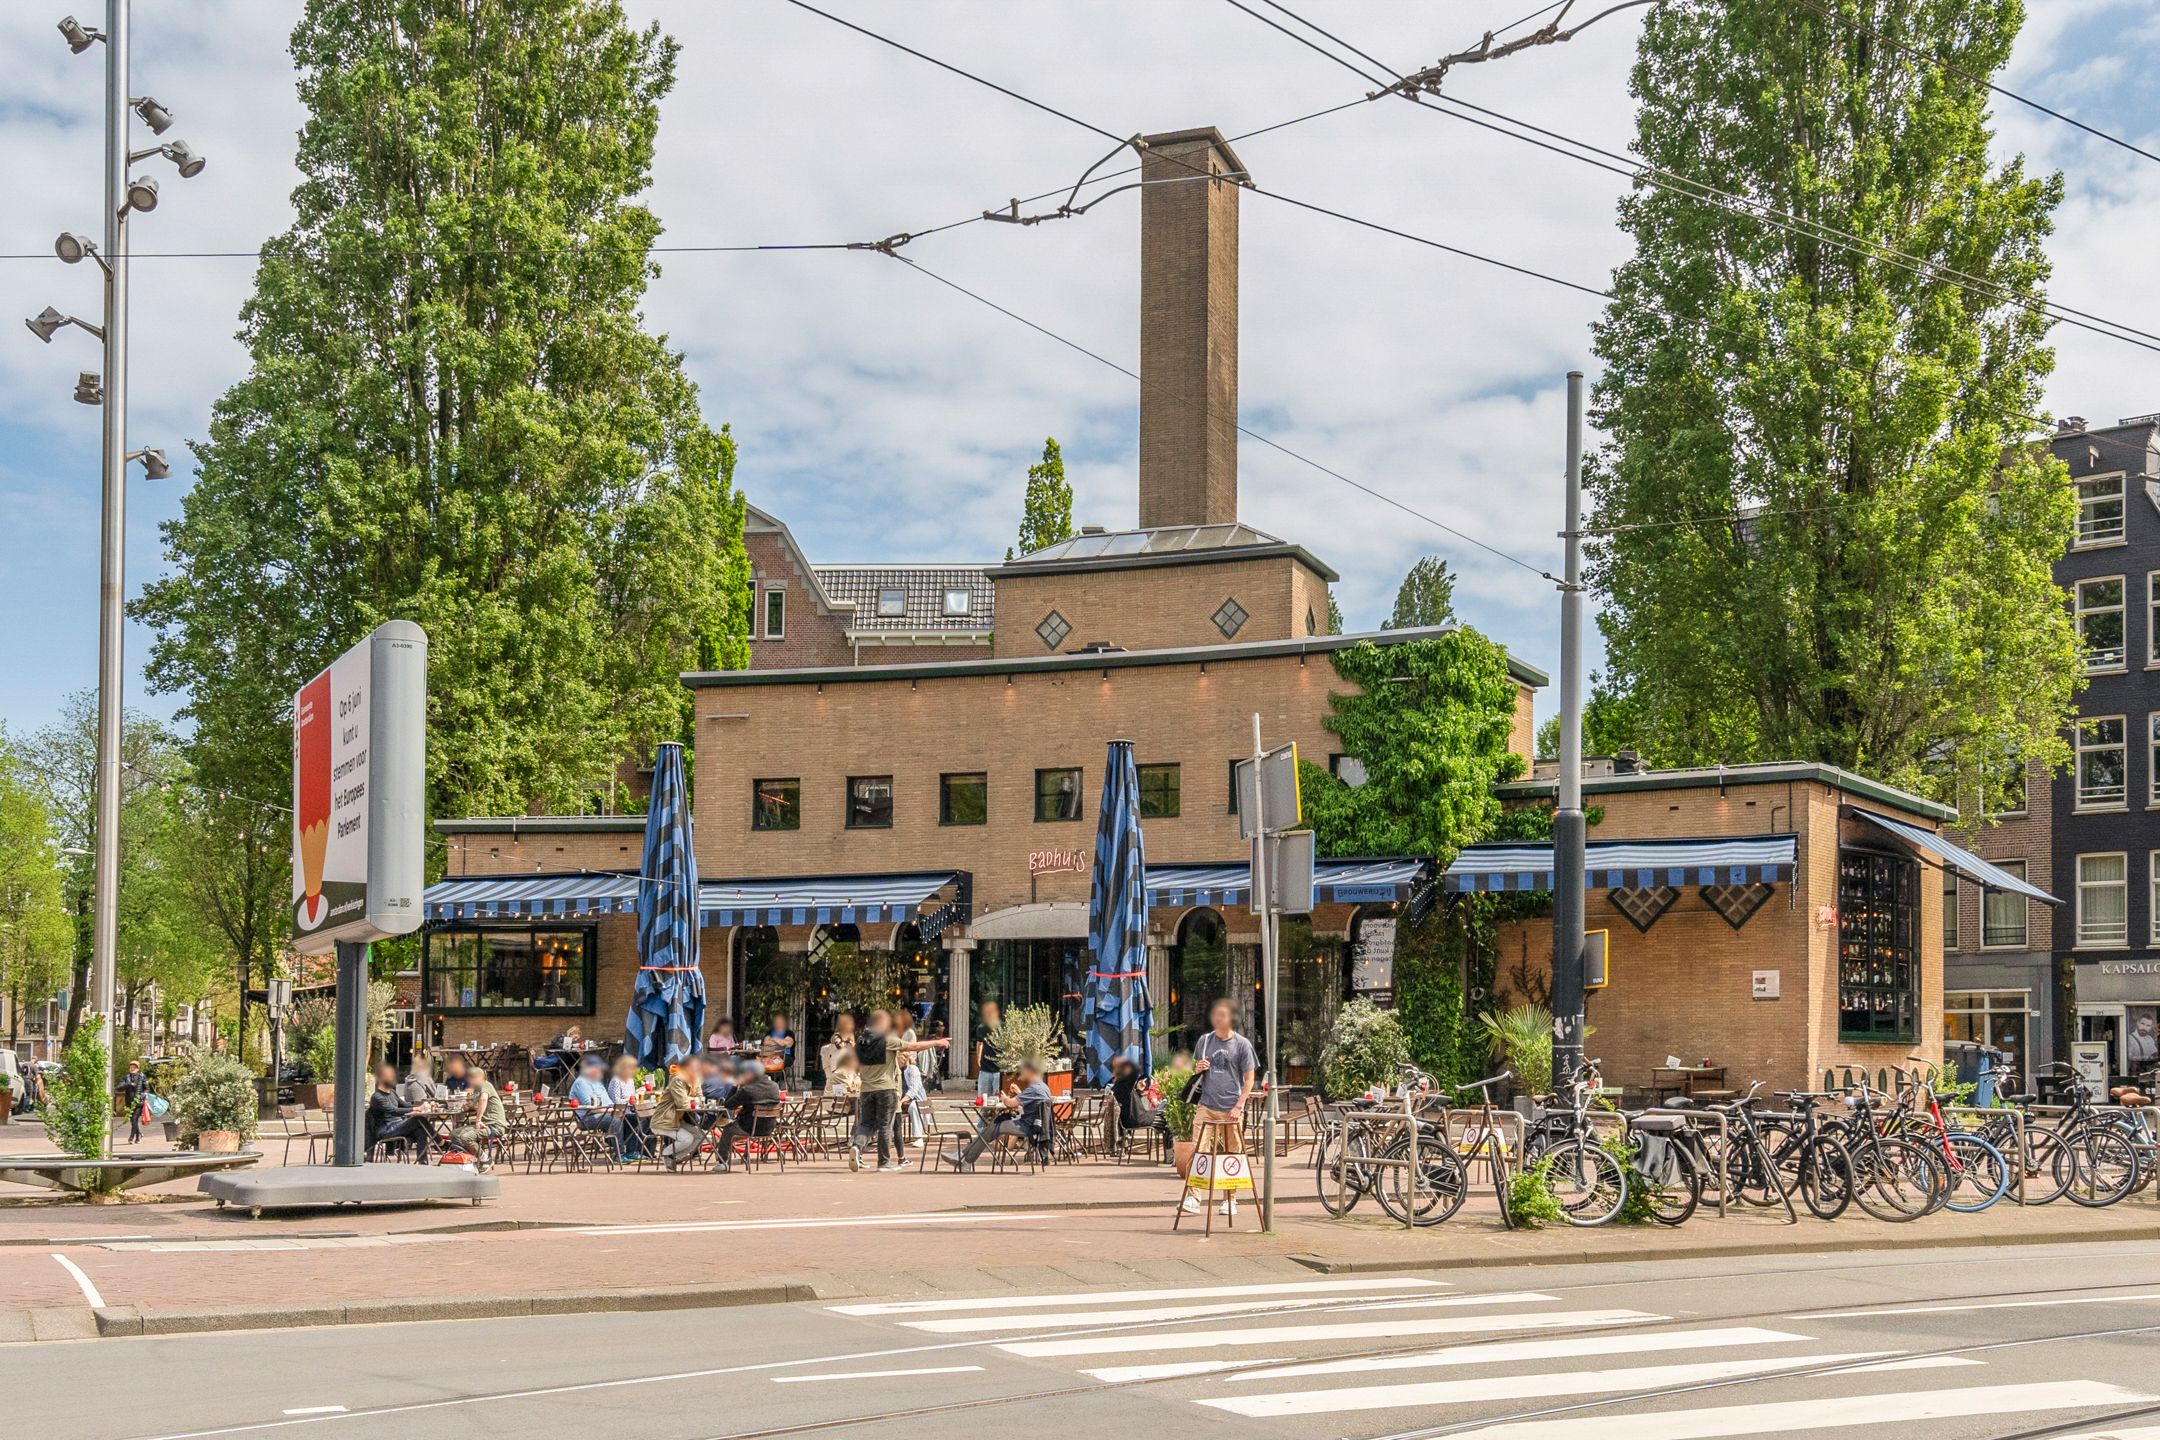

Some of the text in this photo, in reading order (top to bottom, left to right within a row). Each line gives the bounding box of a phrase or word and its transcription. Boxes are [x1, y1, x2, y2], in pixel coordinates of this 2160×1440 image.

[339, 685, 362, 720] Op 6 juni
[342, 724, 355, 746] kunt
[333, 749, 367, 782] stemmen voor
[335, 781, 365, 812] het Europees
[337, 812, 361, 840] Parlement
